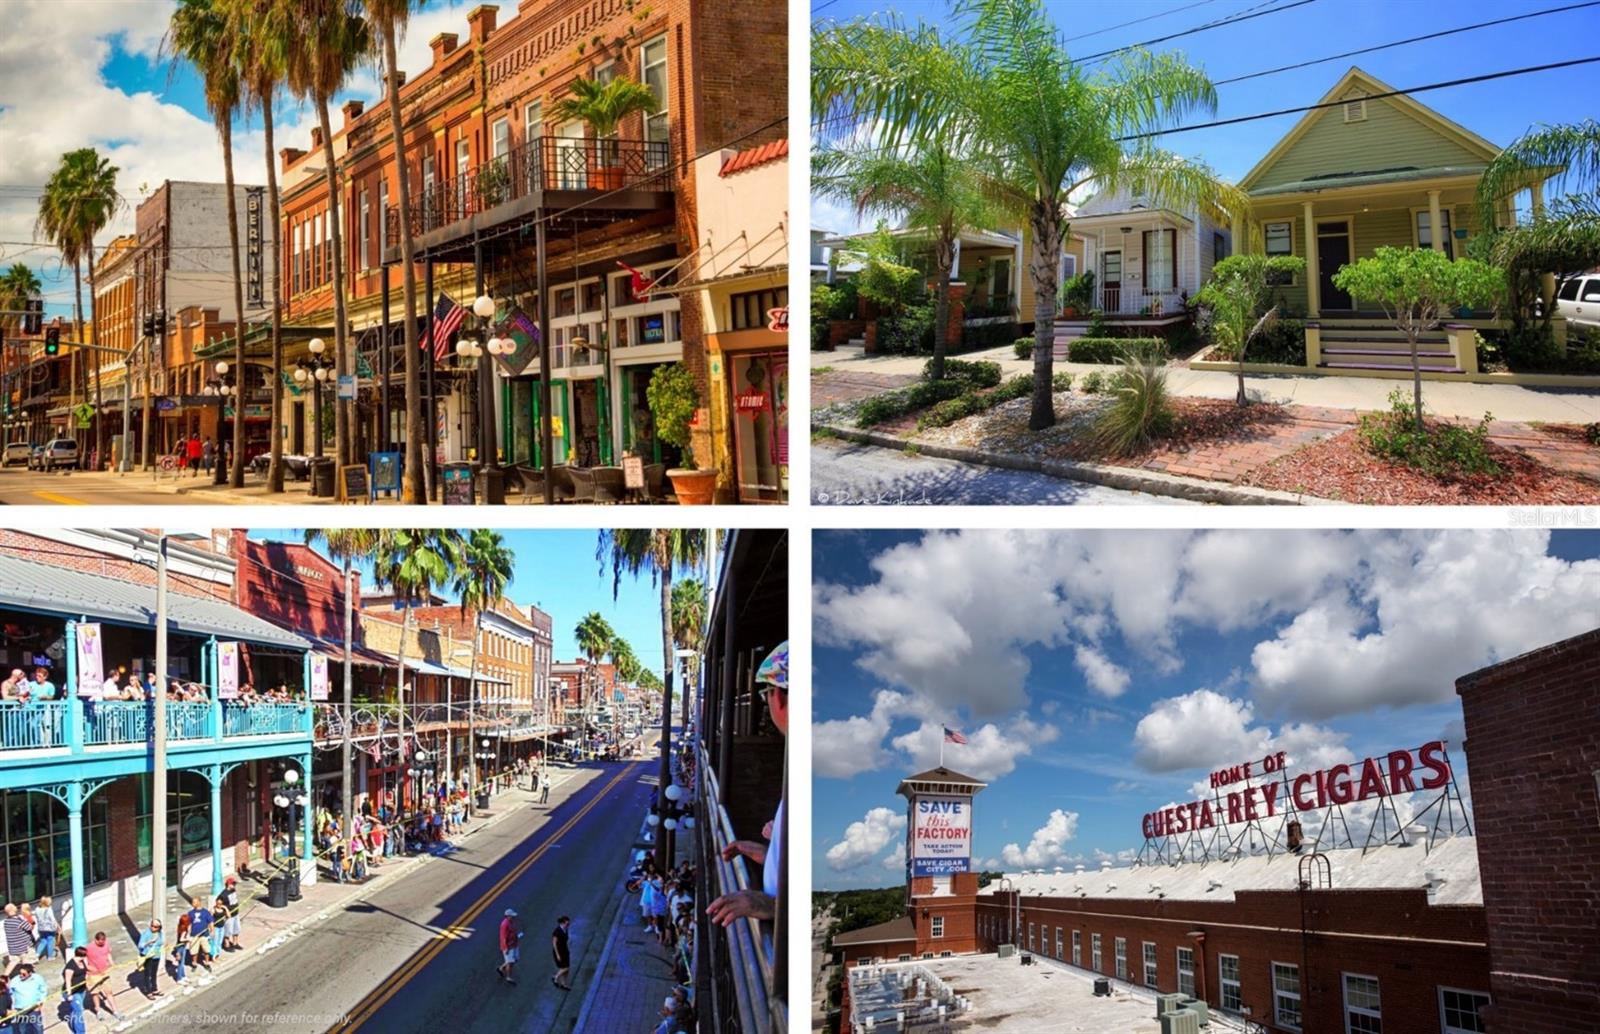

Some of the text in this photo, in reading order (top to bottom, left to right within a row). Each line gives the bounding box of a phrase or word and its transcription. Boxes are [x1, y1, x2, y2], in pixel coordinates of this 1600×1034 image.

[249, 201, 258, 299] BERNINI
[1210, 751, 1286, 788] HOME OF
[1142, 741, 1450, 839] CUESTA REY CIGARS
[919, 801, 961, 814] SAVE
[917, 827, 968, 839] FACTORY
[926, 814, 950, 827] this
